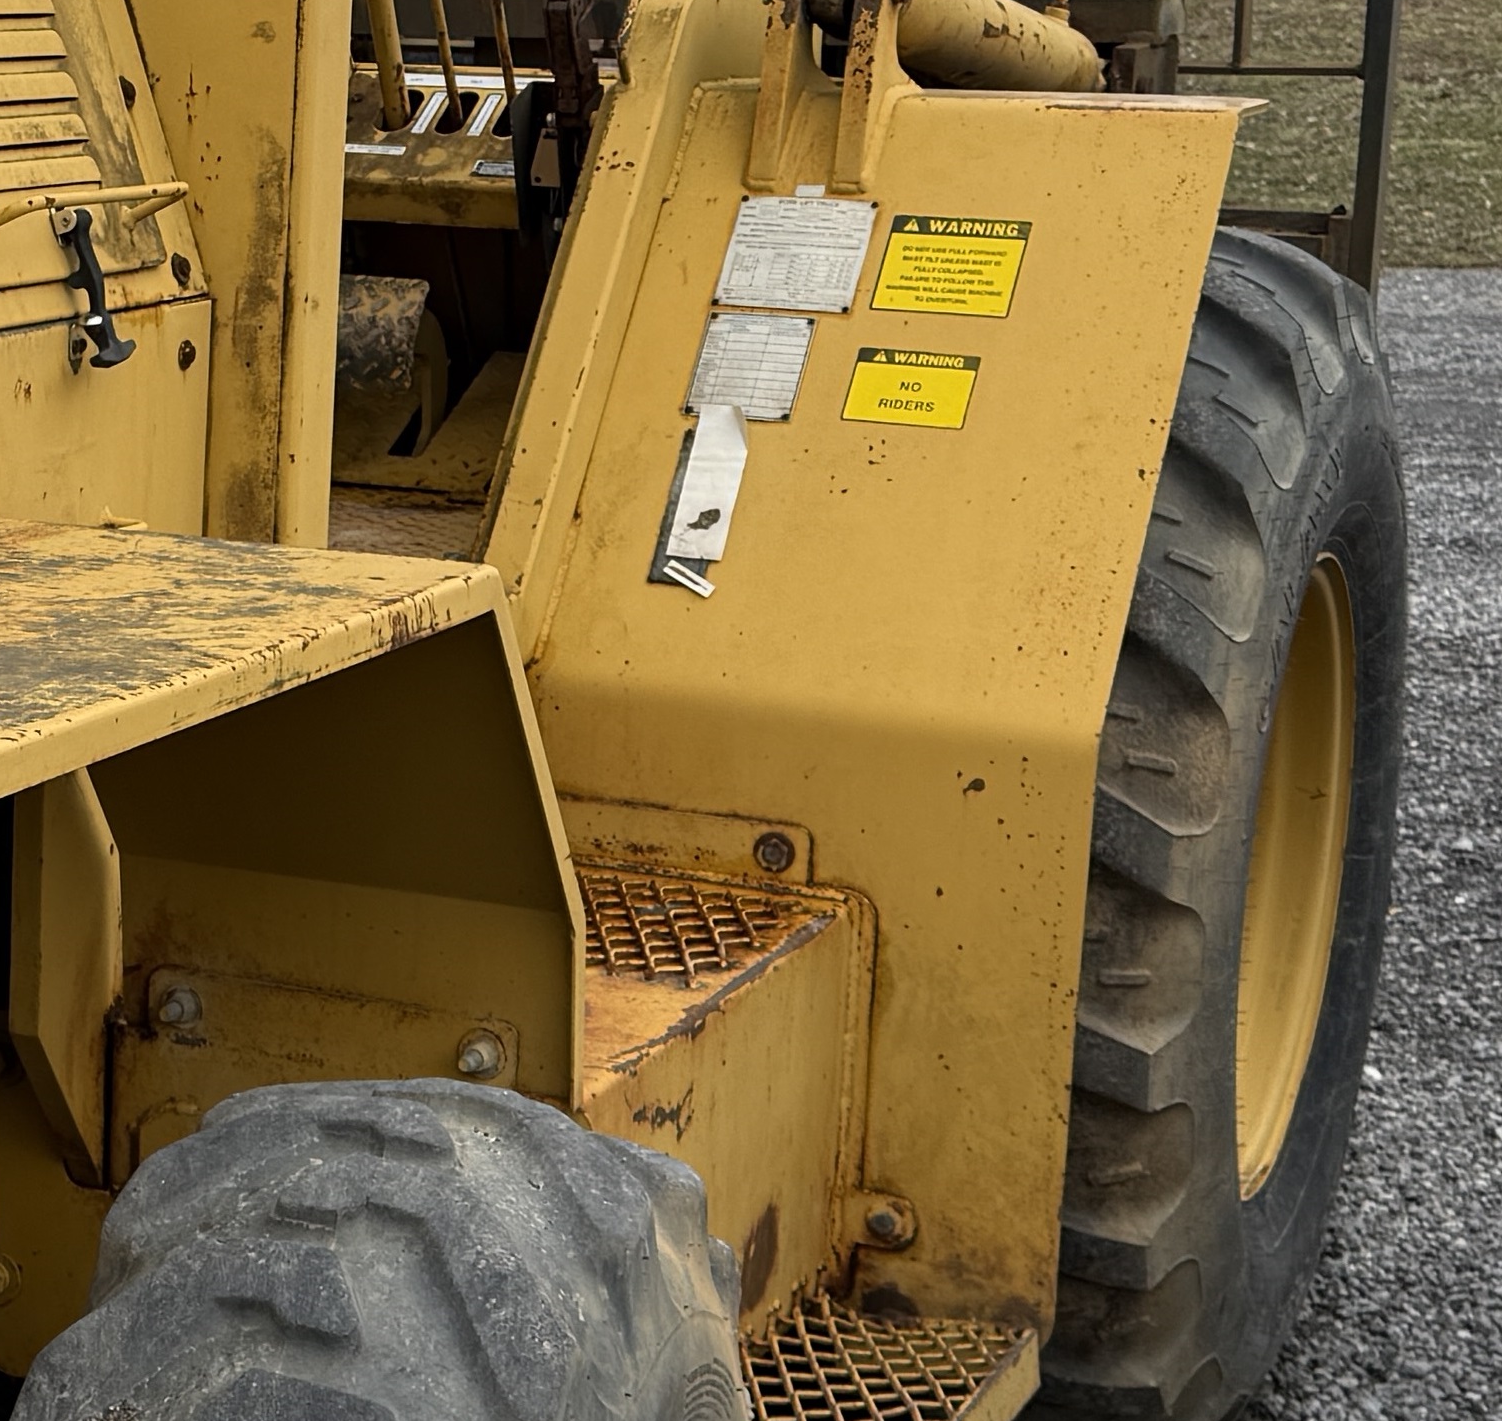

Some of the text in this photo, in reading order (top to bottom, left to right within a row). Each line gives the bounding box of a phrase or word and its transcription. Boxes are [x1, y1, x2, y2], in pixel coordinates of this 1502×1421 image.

[929, 220, 1019, 237] WARNING
[894, 352, 965, 368] WARNING
[899, 381, 922, 392] NO
[878, 398, 935, 412] RIDERS
